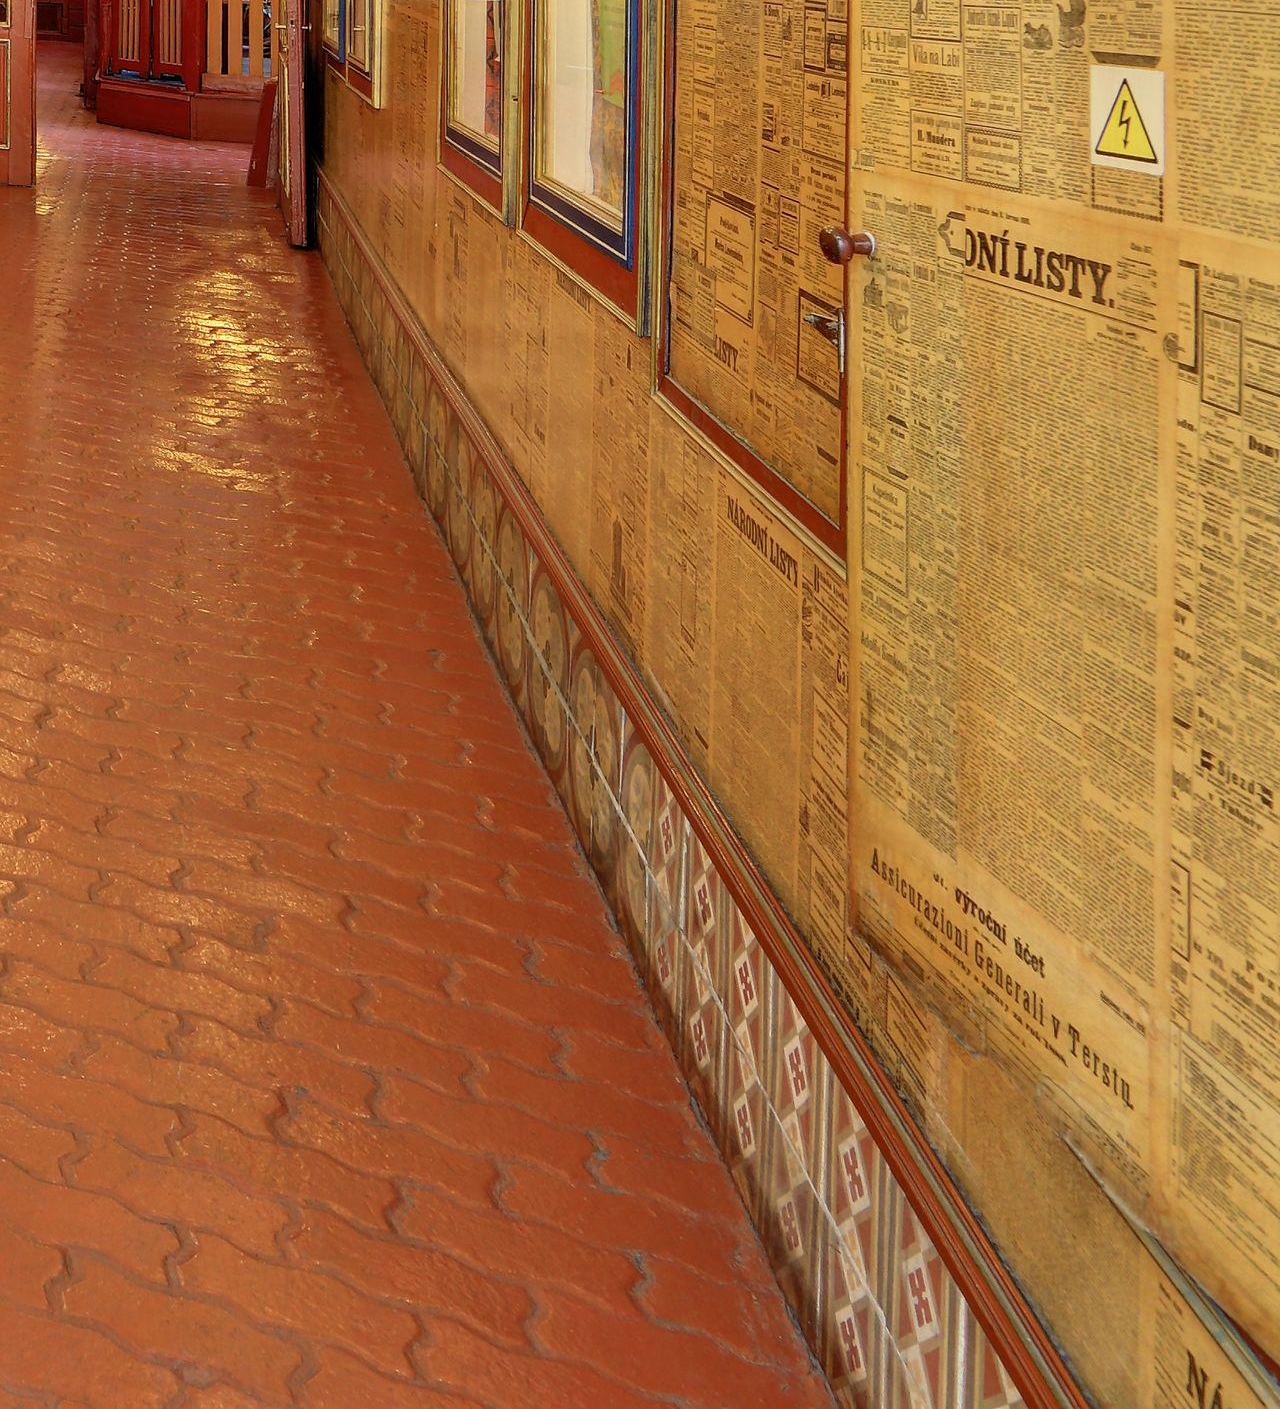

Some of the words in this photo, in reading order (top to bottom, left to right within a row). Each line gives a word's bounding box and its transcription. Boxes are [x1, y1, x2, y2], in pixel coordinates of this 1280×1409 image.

[1014, 241, 1116, 309] LISTY.
[727, 494, 768, 555] NÁRODNÍ
[869, 847, 971, 958] Assicurazioni
[974, 941, 1047, 1027] Generali
[1050, 1013, 1062, 1040] v
[954, 883, 1008, 944] výroční
[1013, 933, 1048, 980] účet
